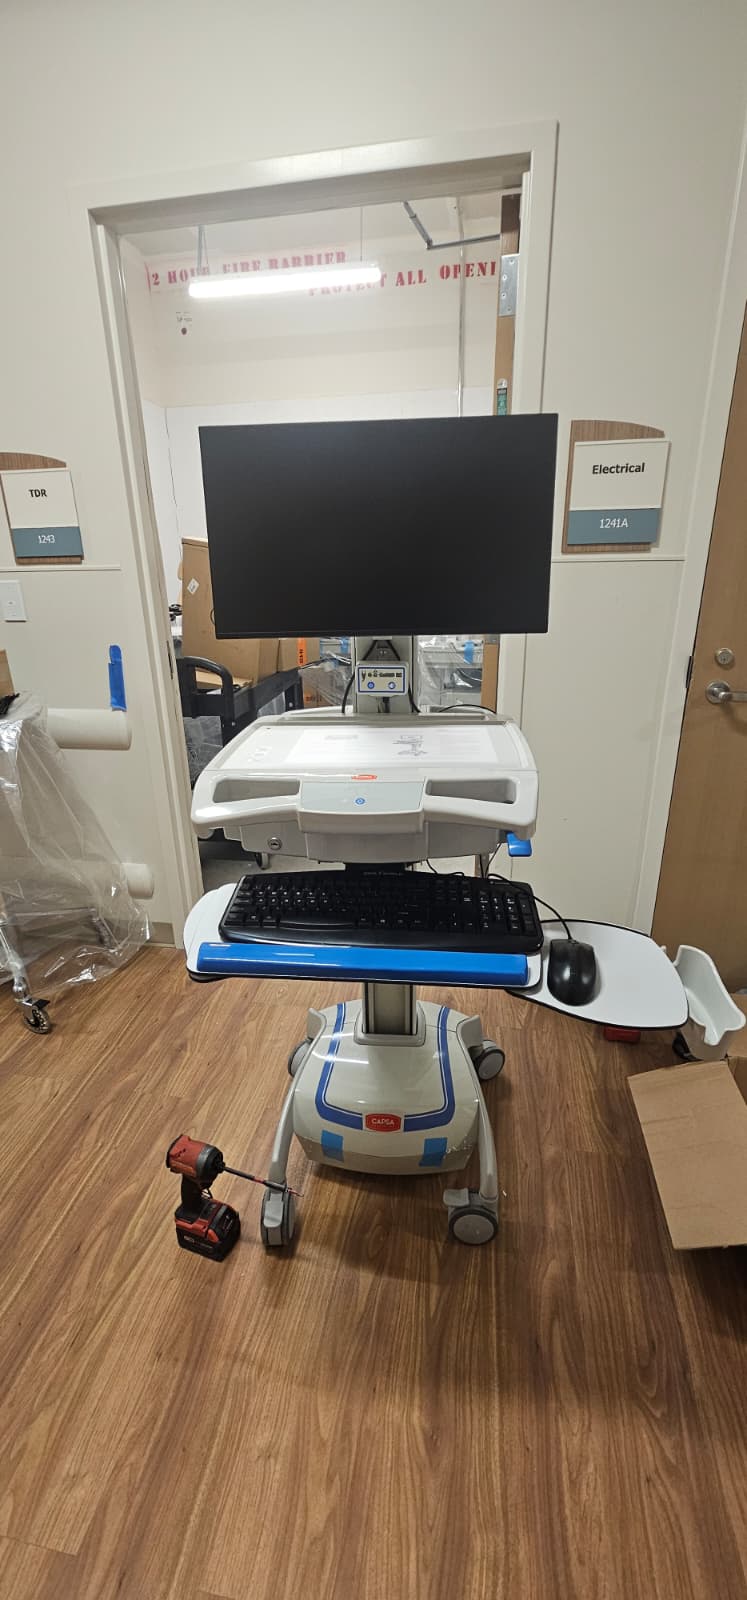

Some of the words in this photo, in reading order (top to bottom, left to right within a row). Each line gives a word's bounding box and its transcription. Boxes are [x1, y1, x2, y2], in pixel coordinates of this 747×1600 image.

[151, 272, 160, 286] 2
[222, 260, 261, 274] FIRE
[268, 251, 346, 270] BARRIER
[395, 268, 427, 287] ALL
[592, 462, 645, 474] Electrical
[28, 489, 47, 498] TDR
[599, 518, 629, 529] 1241A
[38, 534, 55, 544] 1243
[371, 1118, 395, 1126] CAPSA
